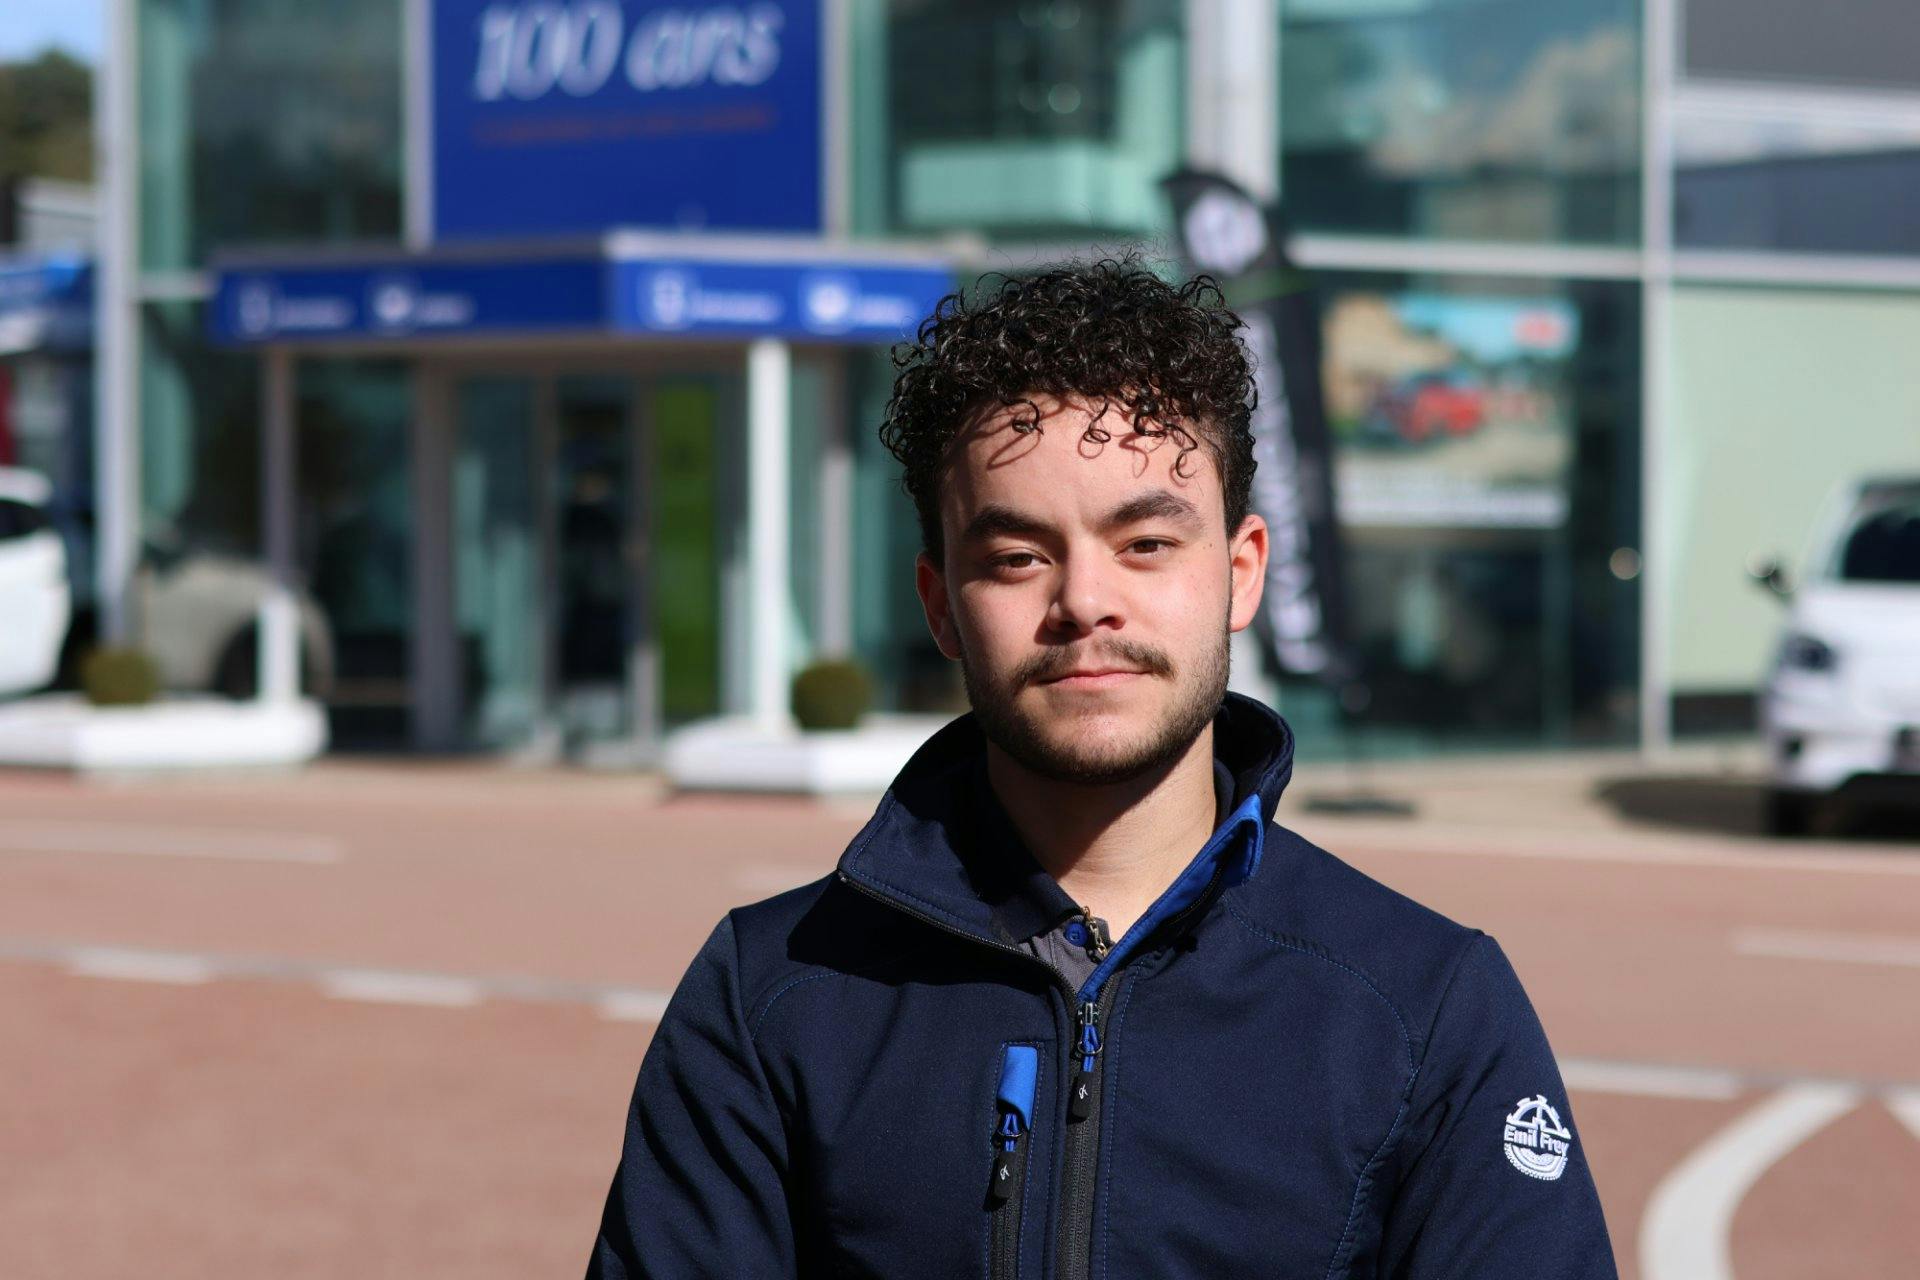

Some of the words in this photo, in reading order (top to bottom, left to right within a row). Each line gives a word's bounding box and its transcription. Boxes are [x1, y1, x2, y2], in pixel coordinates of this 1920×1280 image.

[475, 0, 623, 101] 100
[625, 2, 784, 91] ans
[1504, 1123, 1538, 1148] Emil
[1540, 1131, 1569, 1157] Frey
